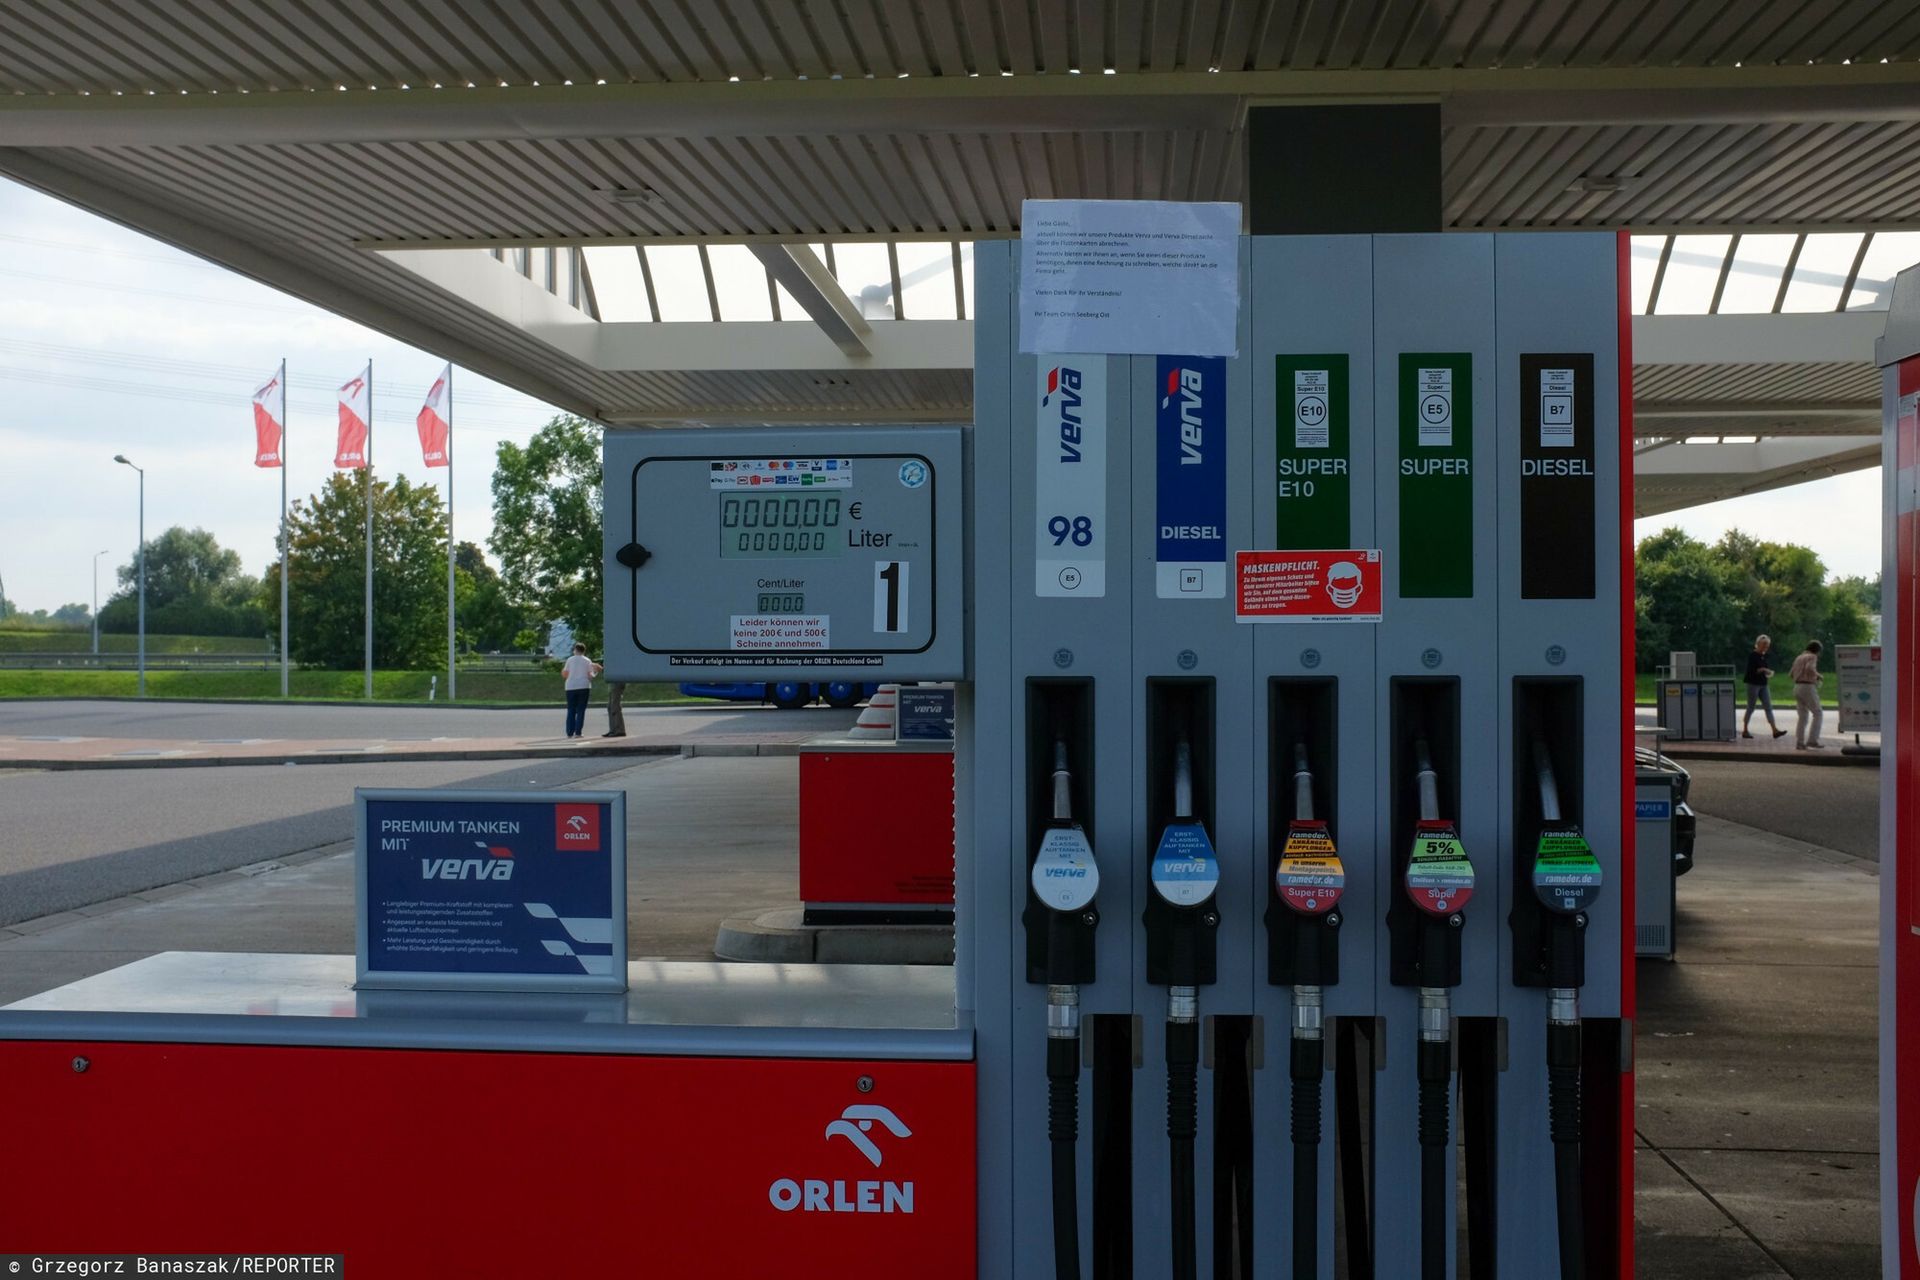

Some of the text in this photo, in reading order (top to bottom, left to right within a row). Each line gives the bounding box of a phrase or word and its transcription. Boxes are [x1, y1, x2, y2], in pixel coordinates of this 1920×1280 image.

[1061, 367, 1082, 463] verva
[1301, 406, 1323, 416] E10
[1428, 404, 1443, 415] E5
[1550, 406, 1565, 415] B7
[1181, 368, 1202, 465] verva
[1280, 458, 1348, 476] SUPER
[1400, 458, 1469, 475] SUPER
[1521, 459, 1594, 476] DIESEL
[1279, 480, 1315, 497] E10
[848, 502, 863, 520] €
[1048, 515, 1093, 547] 98
[1161, 526, 1221, 540] DIESEL
[849, 530, 893, 548] Liter
[1243, 560, 1320, 575] MASKENPFLICHT.
[757, 578, 806, 589] Cent/Liter
[1065, 574, 1075, 582] E5
[1187, 576, 1197, 584] B7
[880, 562, 900, 632] 1
[740, 618, 820, 627] Leider können wir
[734, 629, 758, 638] keine
[784, 629, 802, 638] und
[736, 640, 824, 649] Scheine annehmen.
[776, 658, 802, 666] Rechnung
[381, 820, 520, 835] PREMIUM TANKEN
[564, 832, 591, 840] ORLEN
[381, 838, 409, 851] MIT
[1426, 841, 1455, 855] 5%
[421, 858, 515, 881] verva
[1045, 868, 1087, 878] verva
[1164, 862, 1206, 873] verva
[1288, 876, 1335, 885] rameder.de
[1545, 874, 1593, 884] rameder.de
[1288, 888, 1335, 898] Super E10
[1428, 889, 1455, 900] Super
[1555, 888, 1584, 897] Diesel
[769, 1178, 914, 1214] ORLEN
